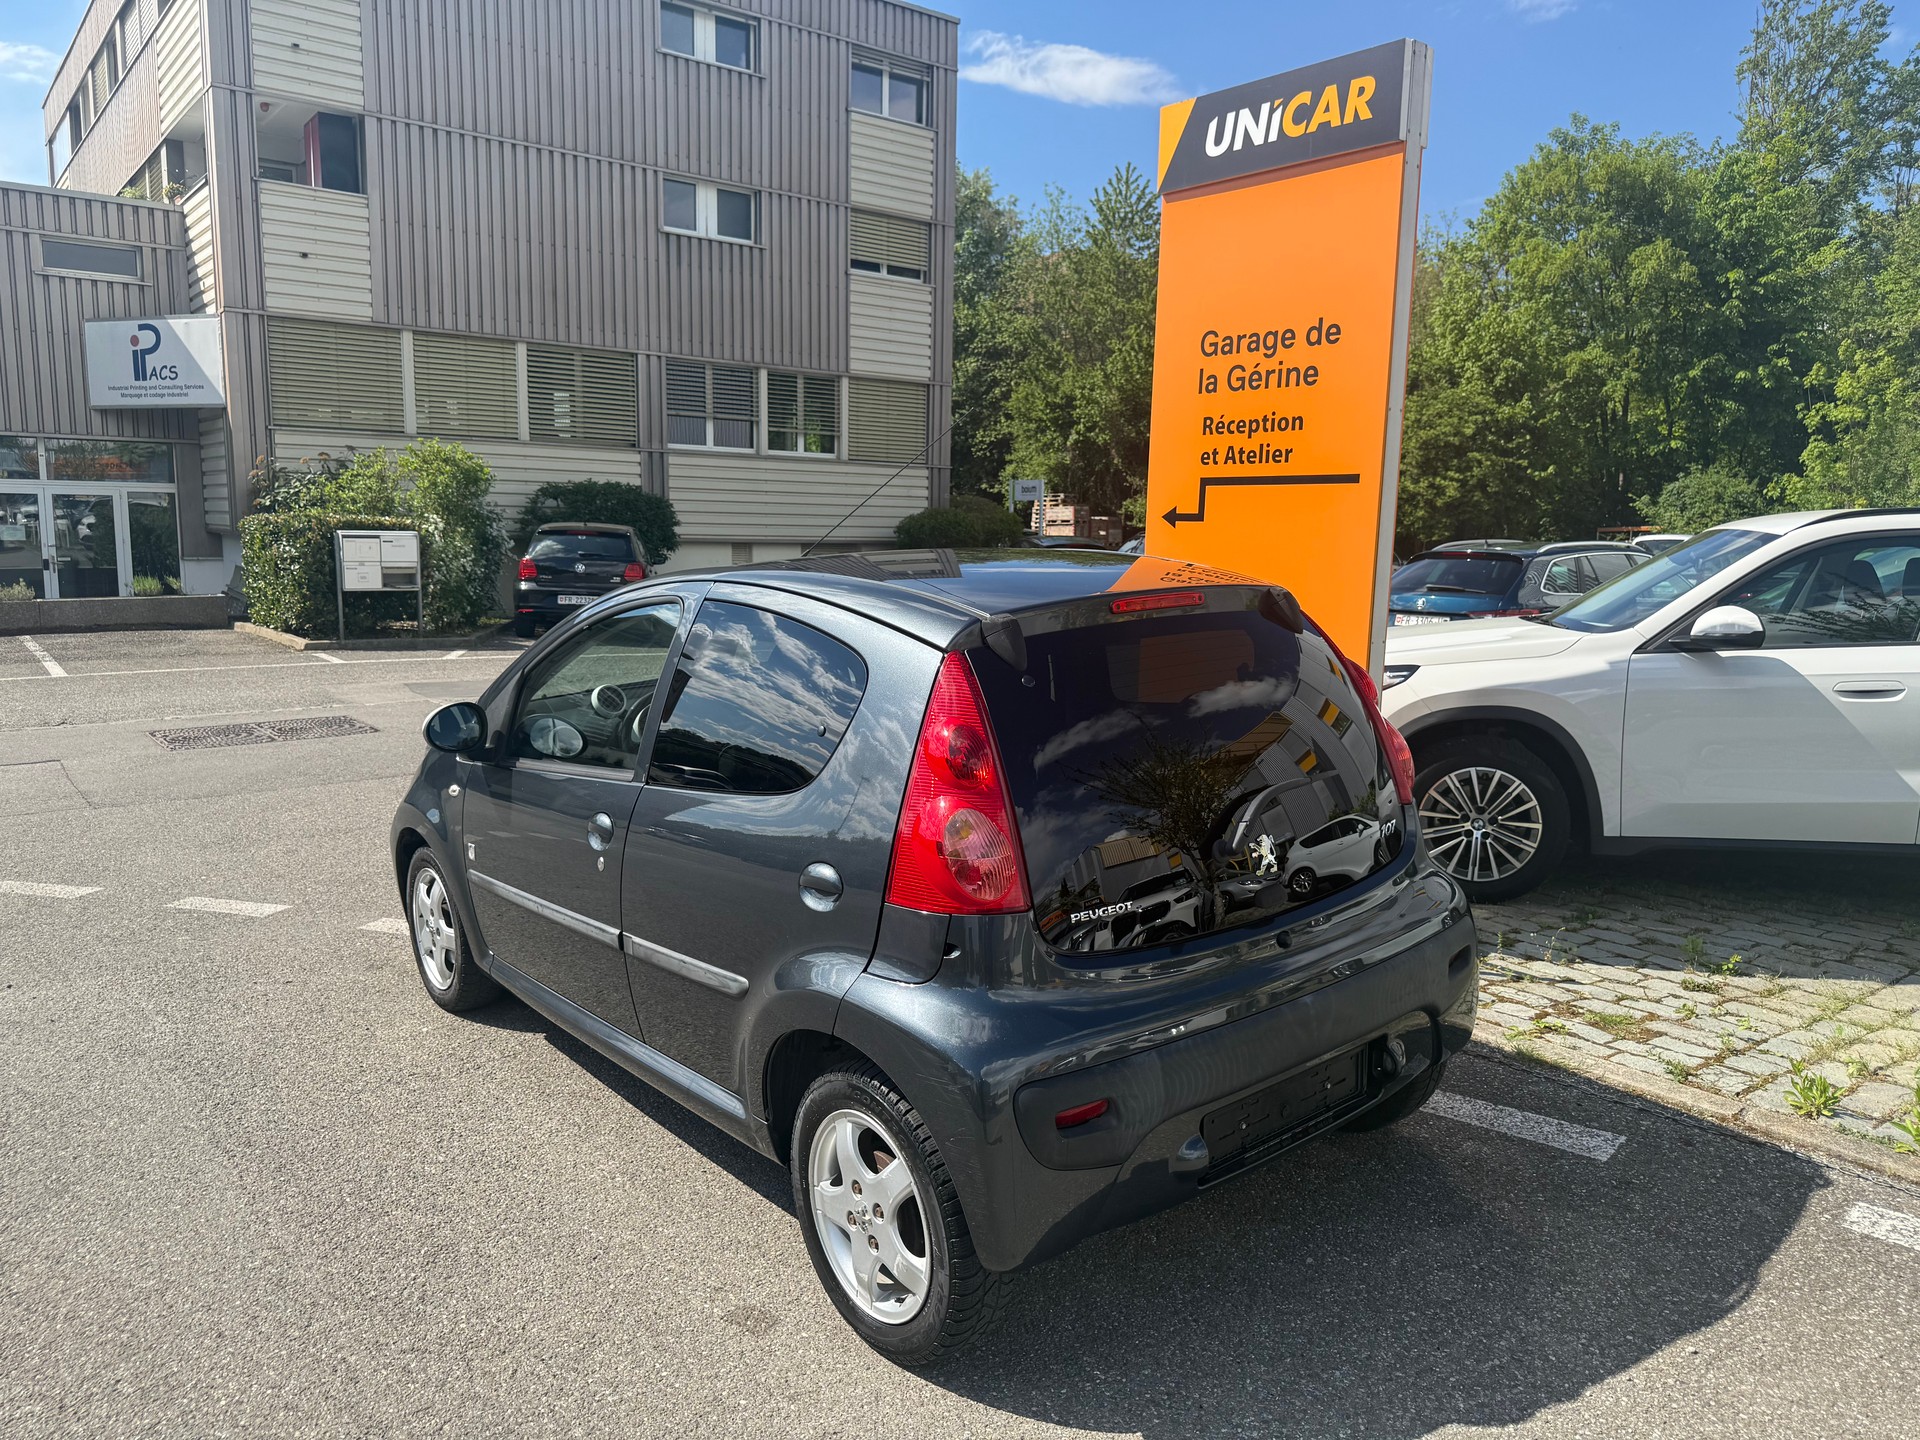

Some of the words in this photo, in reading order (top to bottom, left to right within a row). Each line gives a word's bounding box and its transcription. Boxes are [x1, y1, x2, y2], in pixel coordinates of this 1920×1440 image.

[1200, 326, 1296, 359] Garage
[1305, 317, 1342, 347] de
[1198, 368, 1218, 395] la
[1226, 361, 1319, 393] Gérine
[1202, 411, 1304, 439] Réception
[1200, 449, 1219, 465] et
[1223, 443, 1293, 465] Atelier
[1381, 818, 1396, 838] 107
[1070, 901, 1133, 924] PEUGEOT
